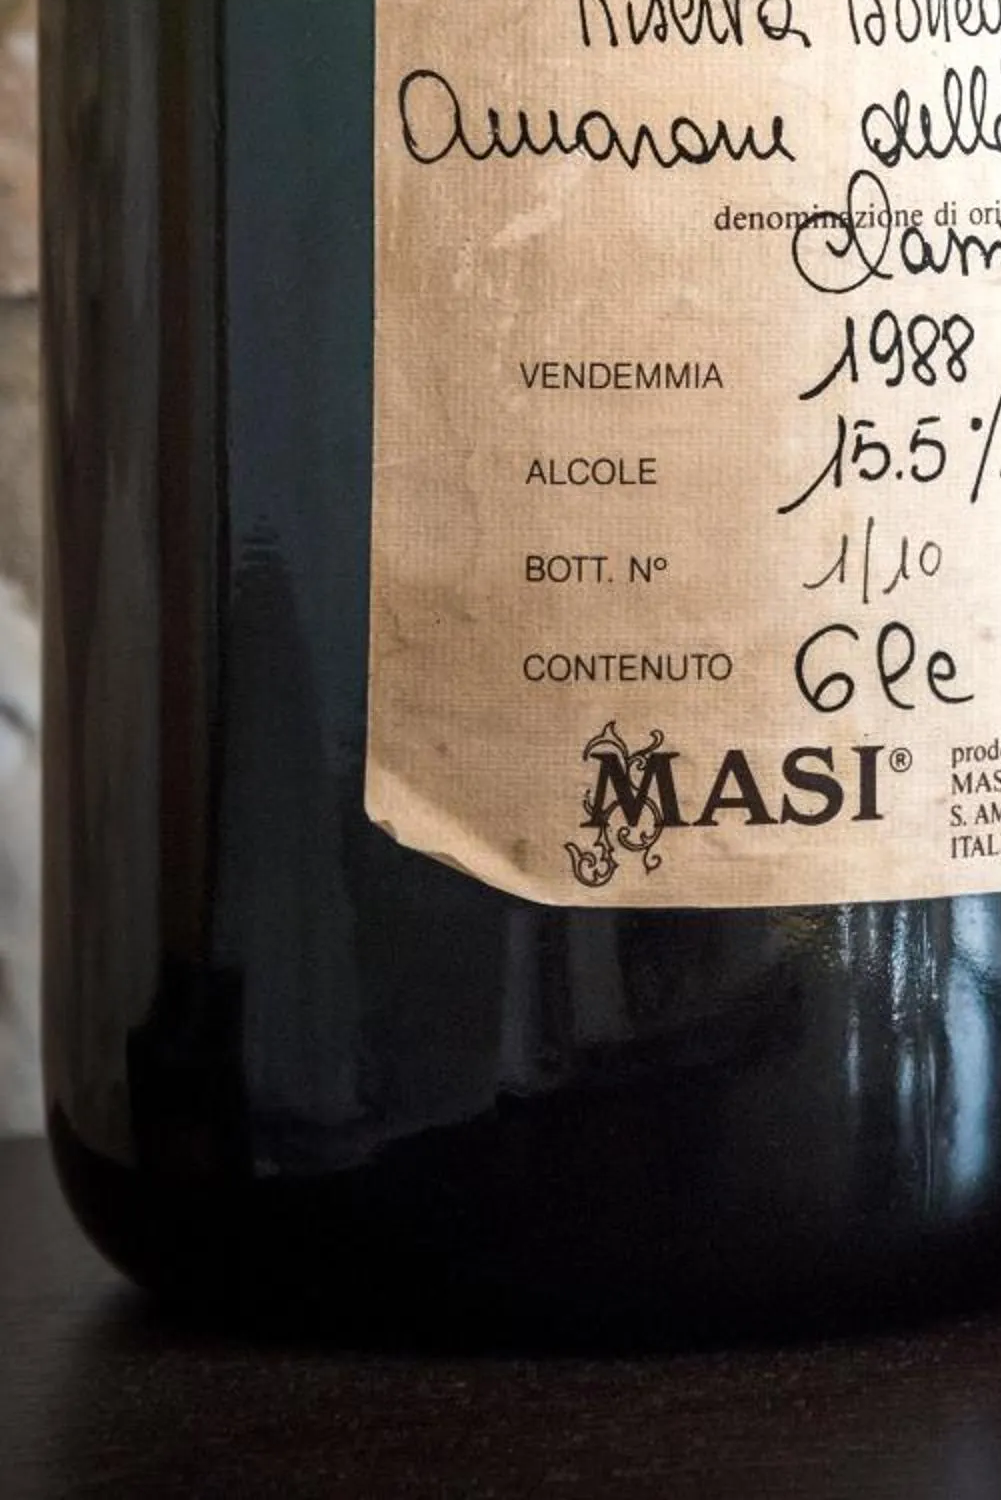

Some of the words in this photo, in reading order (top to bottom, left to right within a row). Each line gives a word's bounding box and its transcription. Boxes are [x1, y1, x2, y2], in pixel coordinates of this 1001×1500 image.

[713, 201, 924, 232] denominazione
[934, 201, 958, 228] di
[797, 309, 976, 401] 1988
[519, 362, 724, 390] VENDEMMIA
[525, 457, 658, 486] ALCOLE
[525, 555, 614, 584] BOTT.
[522, 653, 734, 682] CONTENUTO
[950, 803, 968, 827] S.
